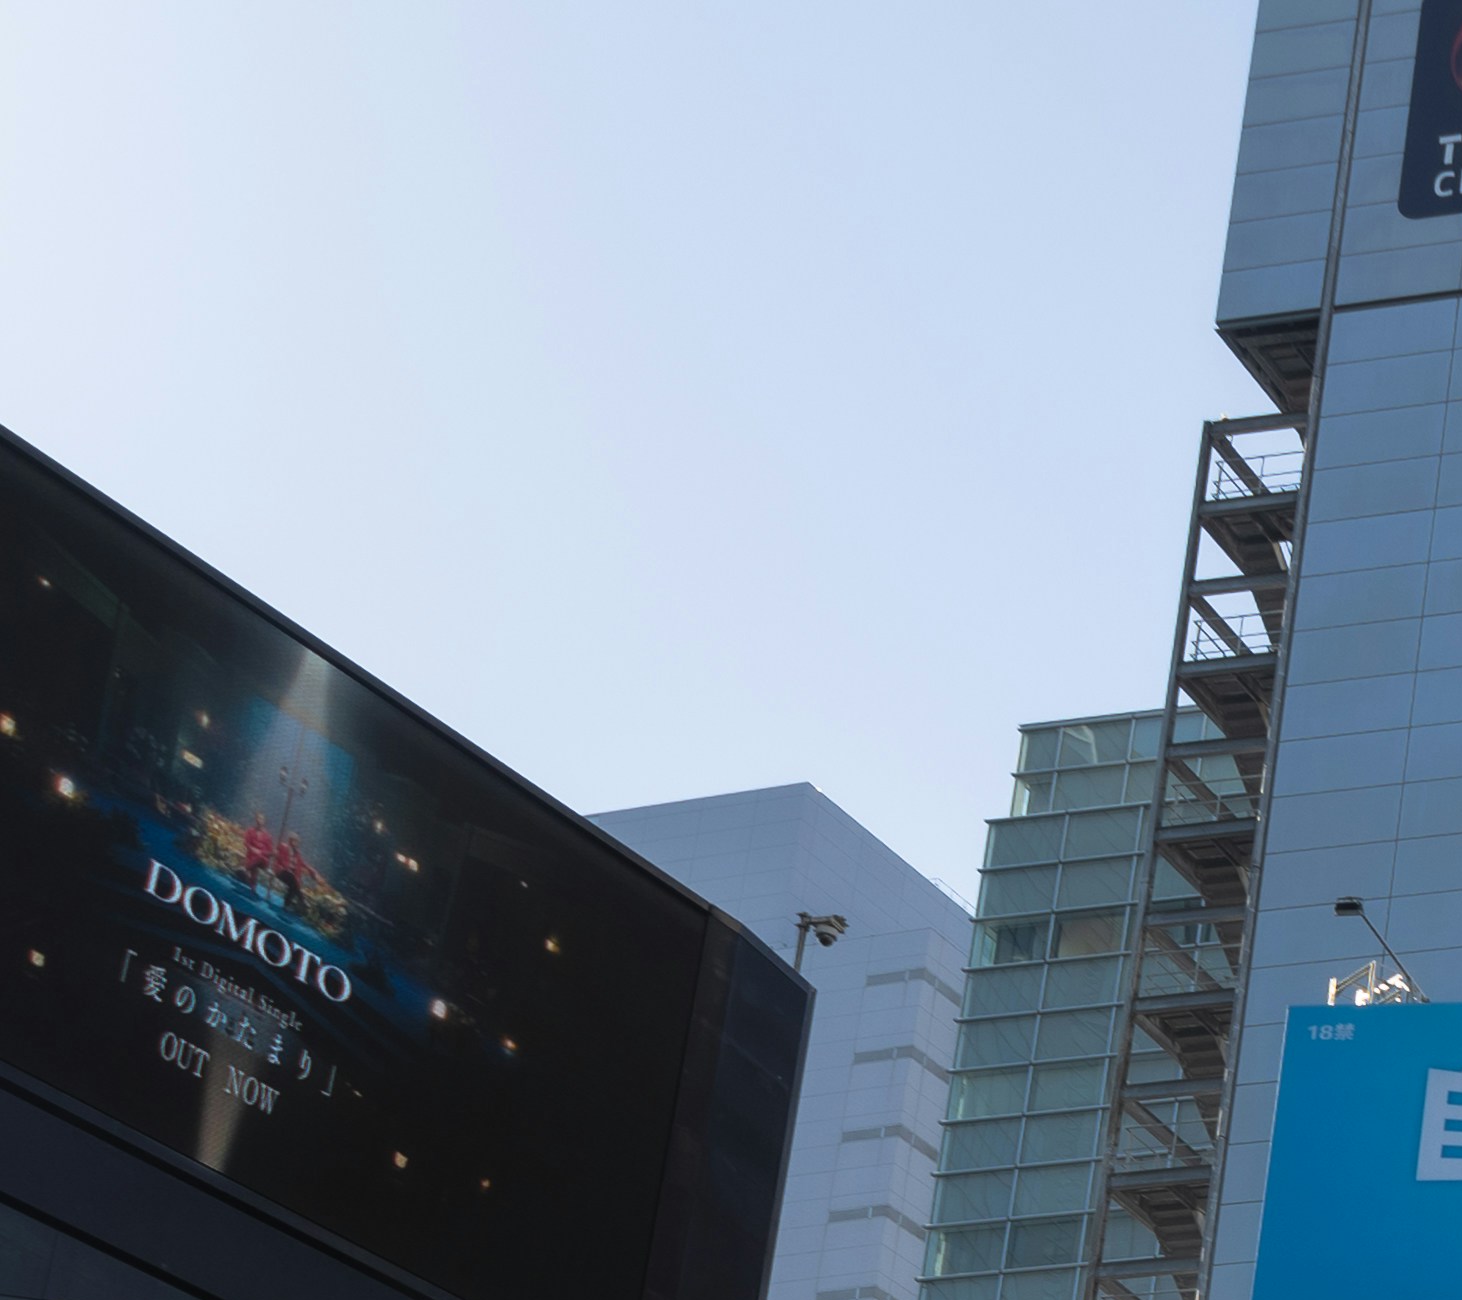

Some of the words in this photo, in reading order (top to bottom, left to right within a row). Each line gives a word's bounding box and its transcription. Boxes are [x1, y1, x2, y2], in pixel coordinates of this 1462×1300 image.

[145, 859, 352, 1003] DOMOTO
[120, 949, 337, 1098] 「愛のかたまり」
[172, 946, 195, 971] 1st
[200, 961, 255, 1004] Digital
[260, 995, 303, 1032] Single
[1307, 1022, 1357, 1042] 18禁
[160, 1032, 211, 1078] OUT
[224, 1064, 281, 1115] NOW
